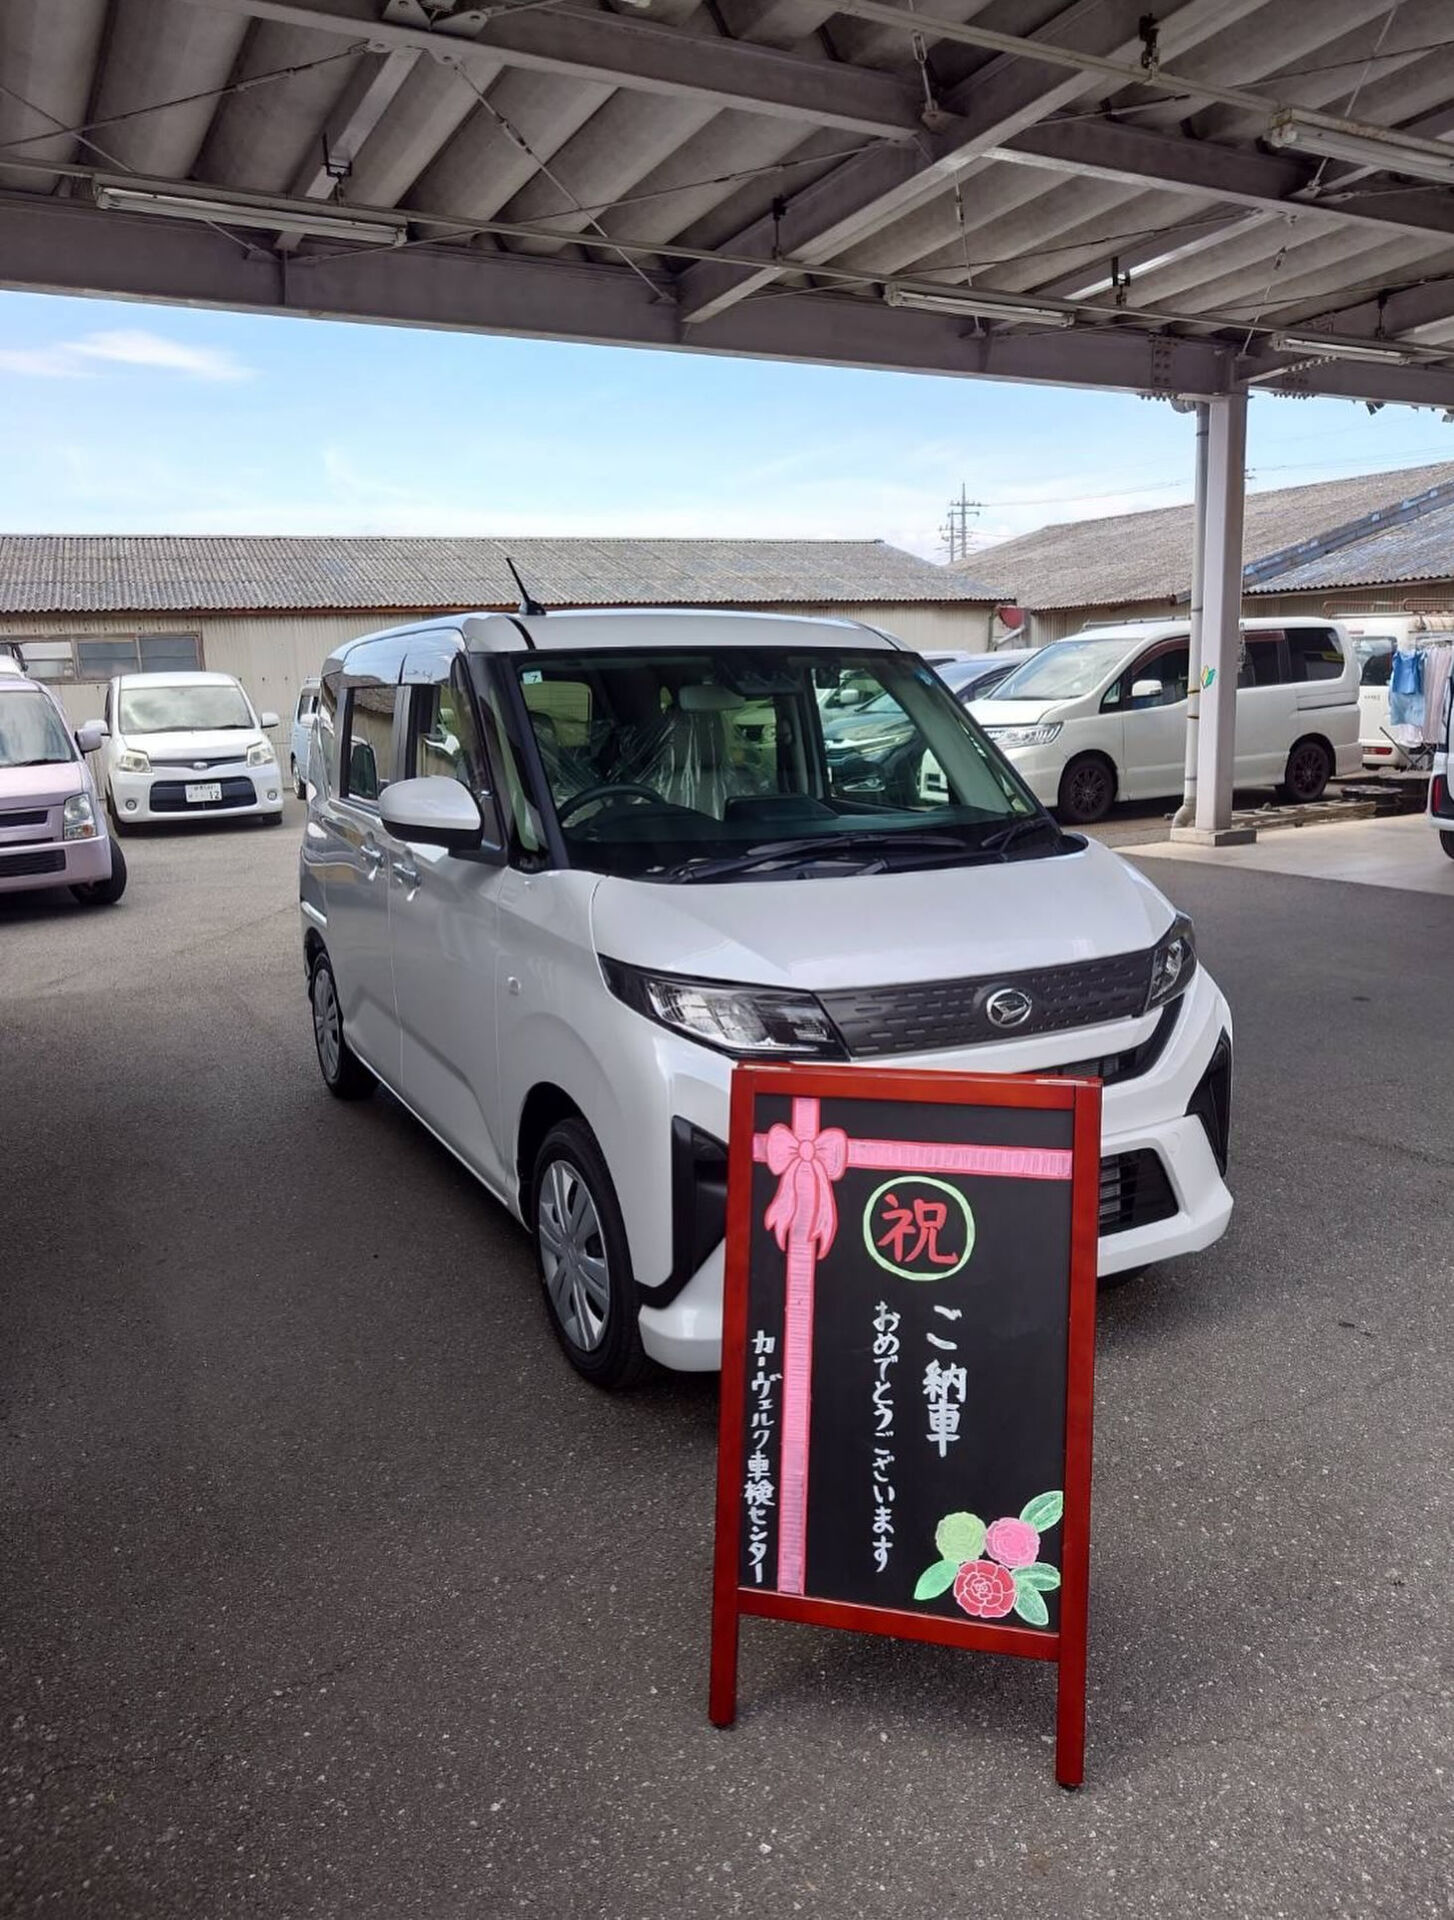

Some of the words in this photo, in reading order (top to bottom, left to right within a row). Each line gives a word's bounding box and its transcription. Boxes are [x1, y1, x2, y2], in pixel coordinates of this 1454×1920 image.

[878, 1194, 958, 1264] 祝
[744, 1330, 783, 1583] カーヴェルク車検センター
[871, 1301, 901, 1573] おめでとうございます
[922, 1304, 968, 1458] ご納車
